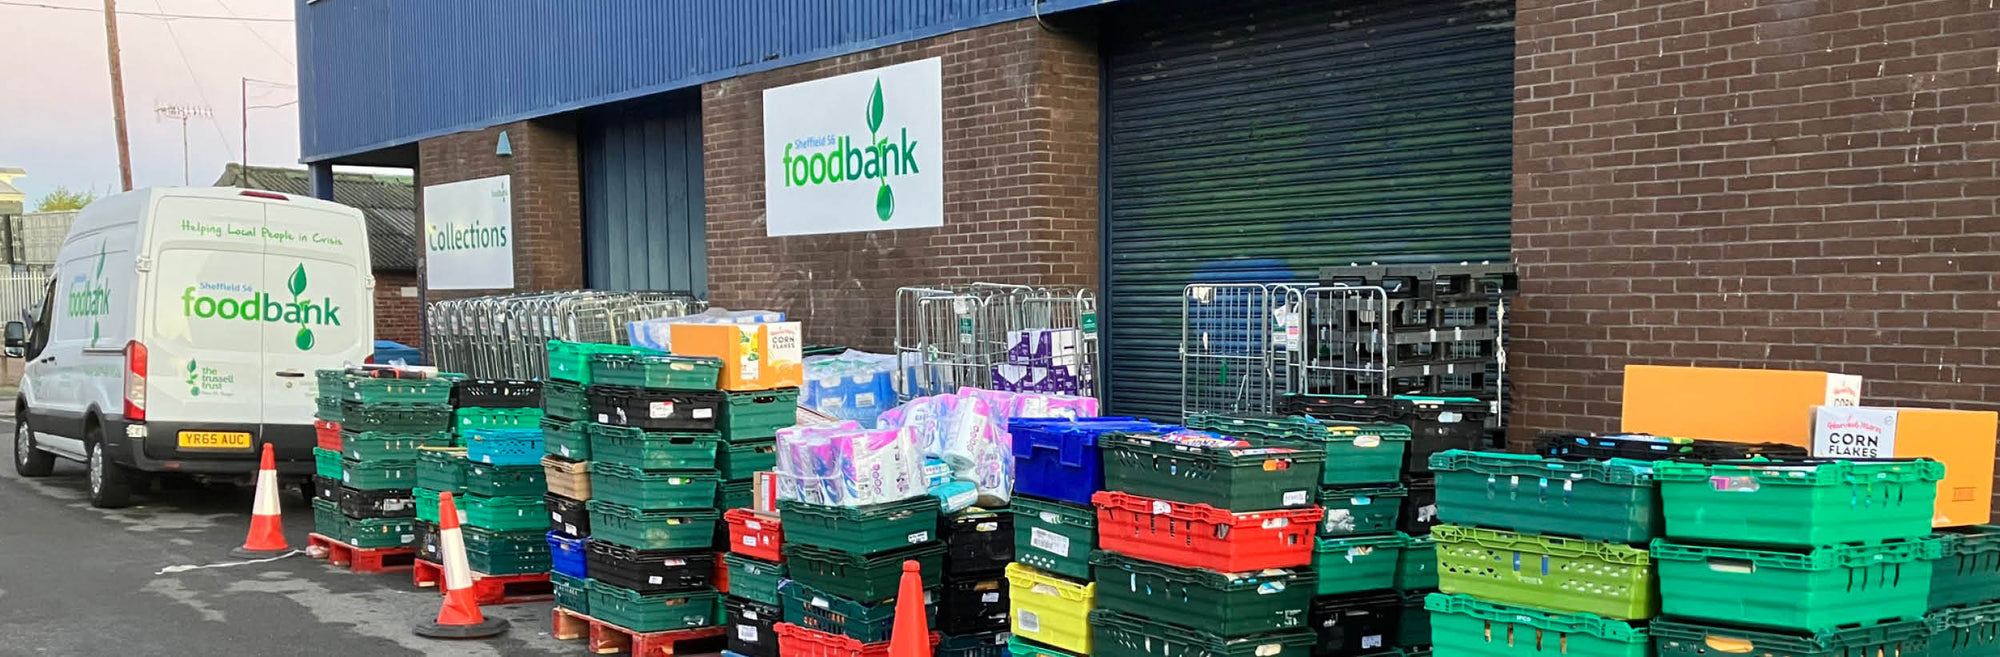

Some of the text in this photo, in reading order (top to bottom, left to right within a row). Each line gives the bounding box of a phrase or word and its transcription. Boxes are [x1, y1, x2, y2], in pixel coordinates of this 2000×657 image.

[794, 135, 825, 149] Sheffield
[783, 127, 919, 187] foodbank
[181, 219, 343, 246] Helping Local People in Crisis
[429, 219, 507, 251] Collections
[69, 277, 111, 317] foodbank
[181, 286, 341, 326] foodbank
[772, 336, 795, 344] CORN
[202, 367, 217, 375] the
[202, 374, 234, 384] trussell
[202, 382, 222, 390] trust
[186, 433, 244, 445] YR65 AUC
[1829, 432, 1879, 447] CORN
[1829, 445, 1878, 458] FLAKES
